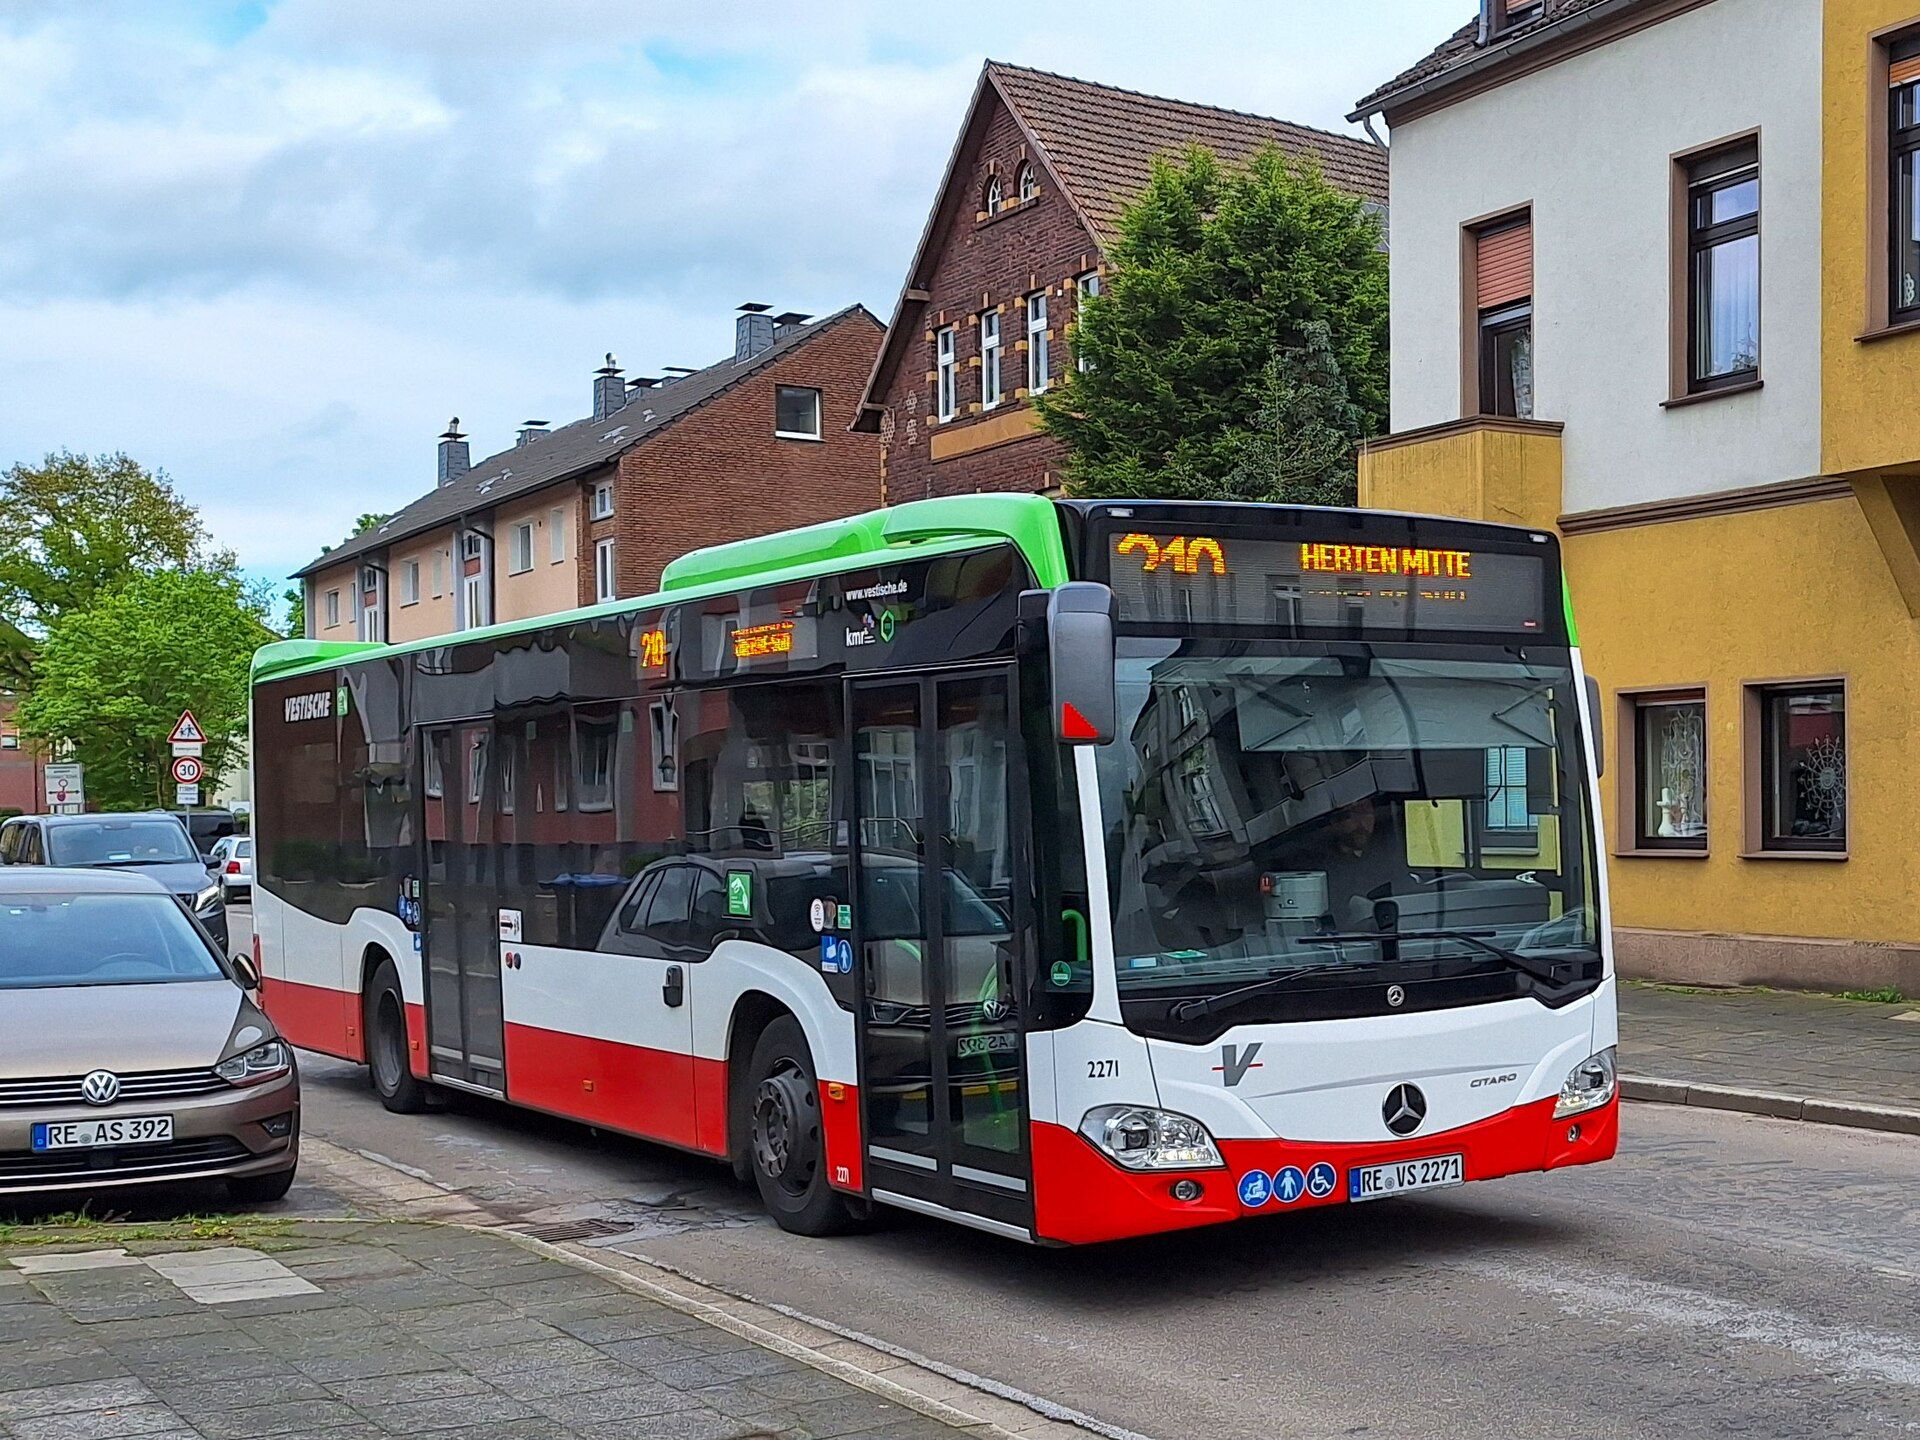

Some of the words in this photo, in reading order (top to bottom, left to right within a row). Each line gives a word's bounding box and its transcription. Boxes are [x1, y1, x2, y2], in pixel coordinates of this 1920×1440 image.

[1301, 543, 1398, 574] HERTEN
[1402, 548, 1472, 578] MITTE
[845, 579, 908, 601] www.vestische.de
[285, 691, 331, 722] VESTISCHE
[179, 764, 195, 776] 30
[1087, 1060, 1119, 1078] 2271
[1470, 1073, 1518, 1088] CITARO
[48, 1125, 78, 1146] RE
[95, 1122, 123, 1143] AS
[129, 1119, 170, 1140] 392
[1362, 1169, 1383, 1193] RE
[1396, 1164, 1417, 1188] VS
[1420, 1157, 1460, 1184] 2271
